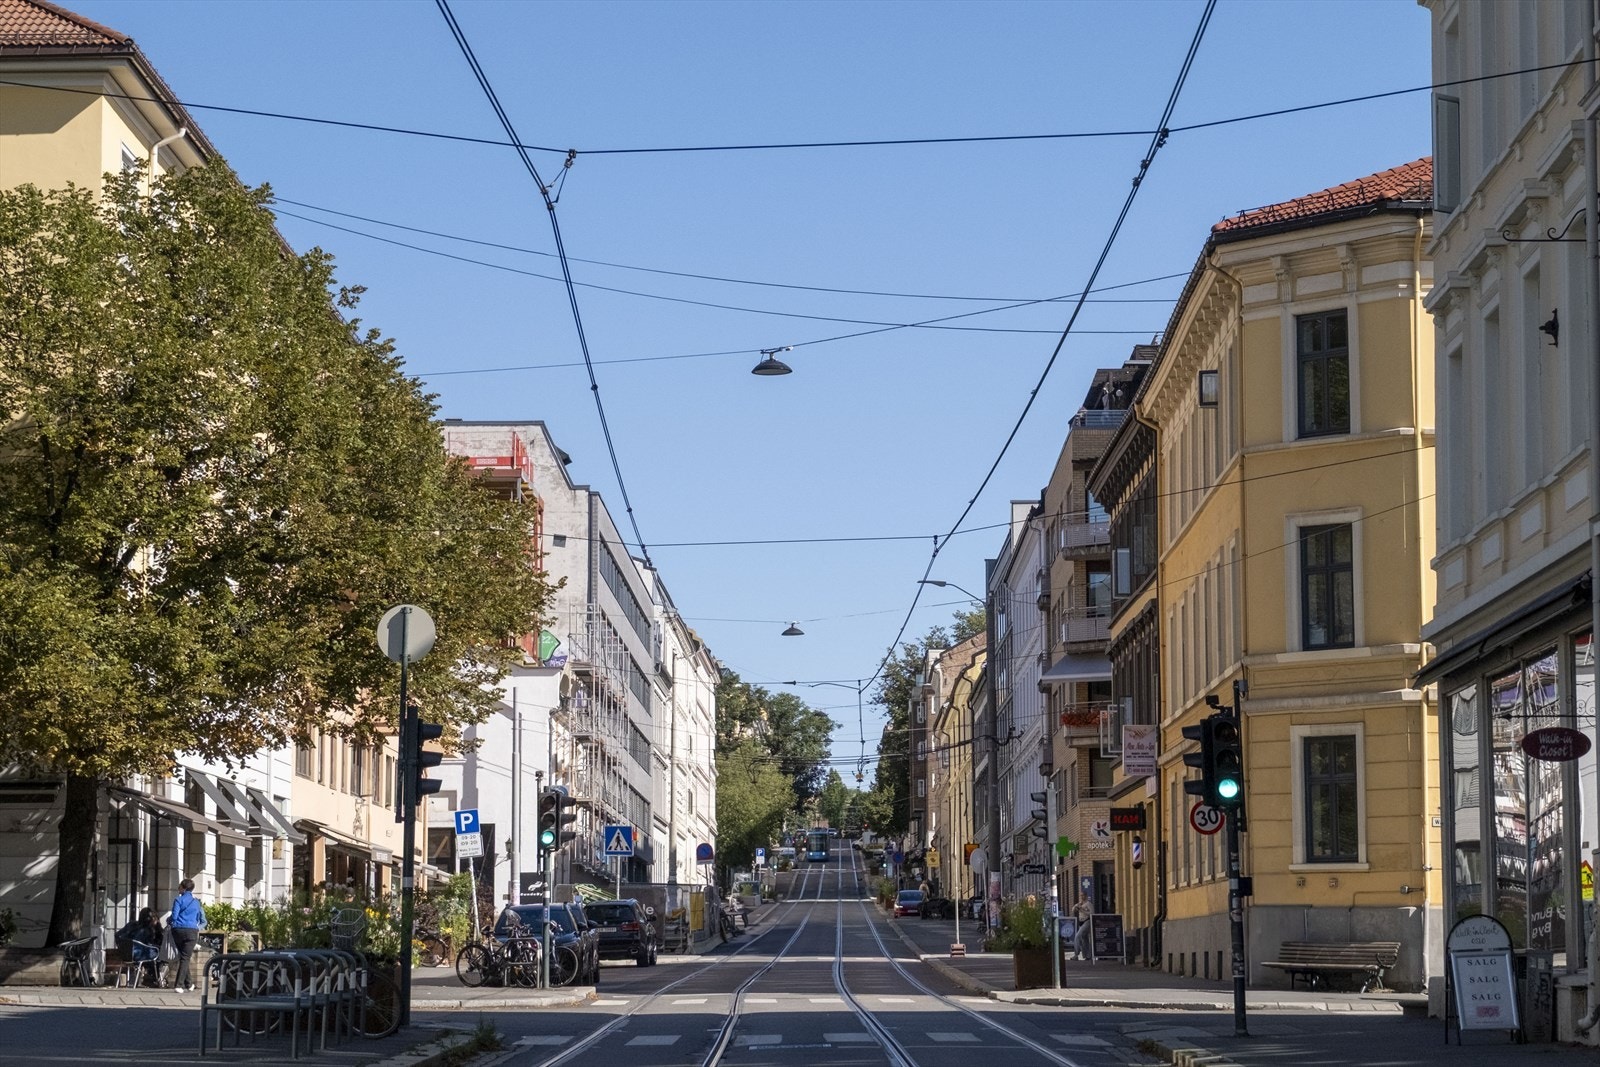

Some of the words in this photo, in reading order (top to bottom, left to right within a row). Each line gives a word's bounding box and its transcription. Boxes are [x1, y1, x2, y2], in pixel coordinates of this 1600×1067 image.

[1539, 745, 1569, 757] Closet
[460, 813, 473, 831] P
[1196, 809, 1219, 827] 30
[1088, 841, 1109, 850] apotek
[1467, 958, 1497, 966] SALG
[1469, 976, 1499, 984] SALG
